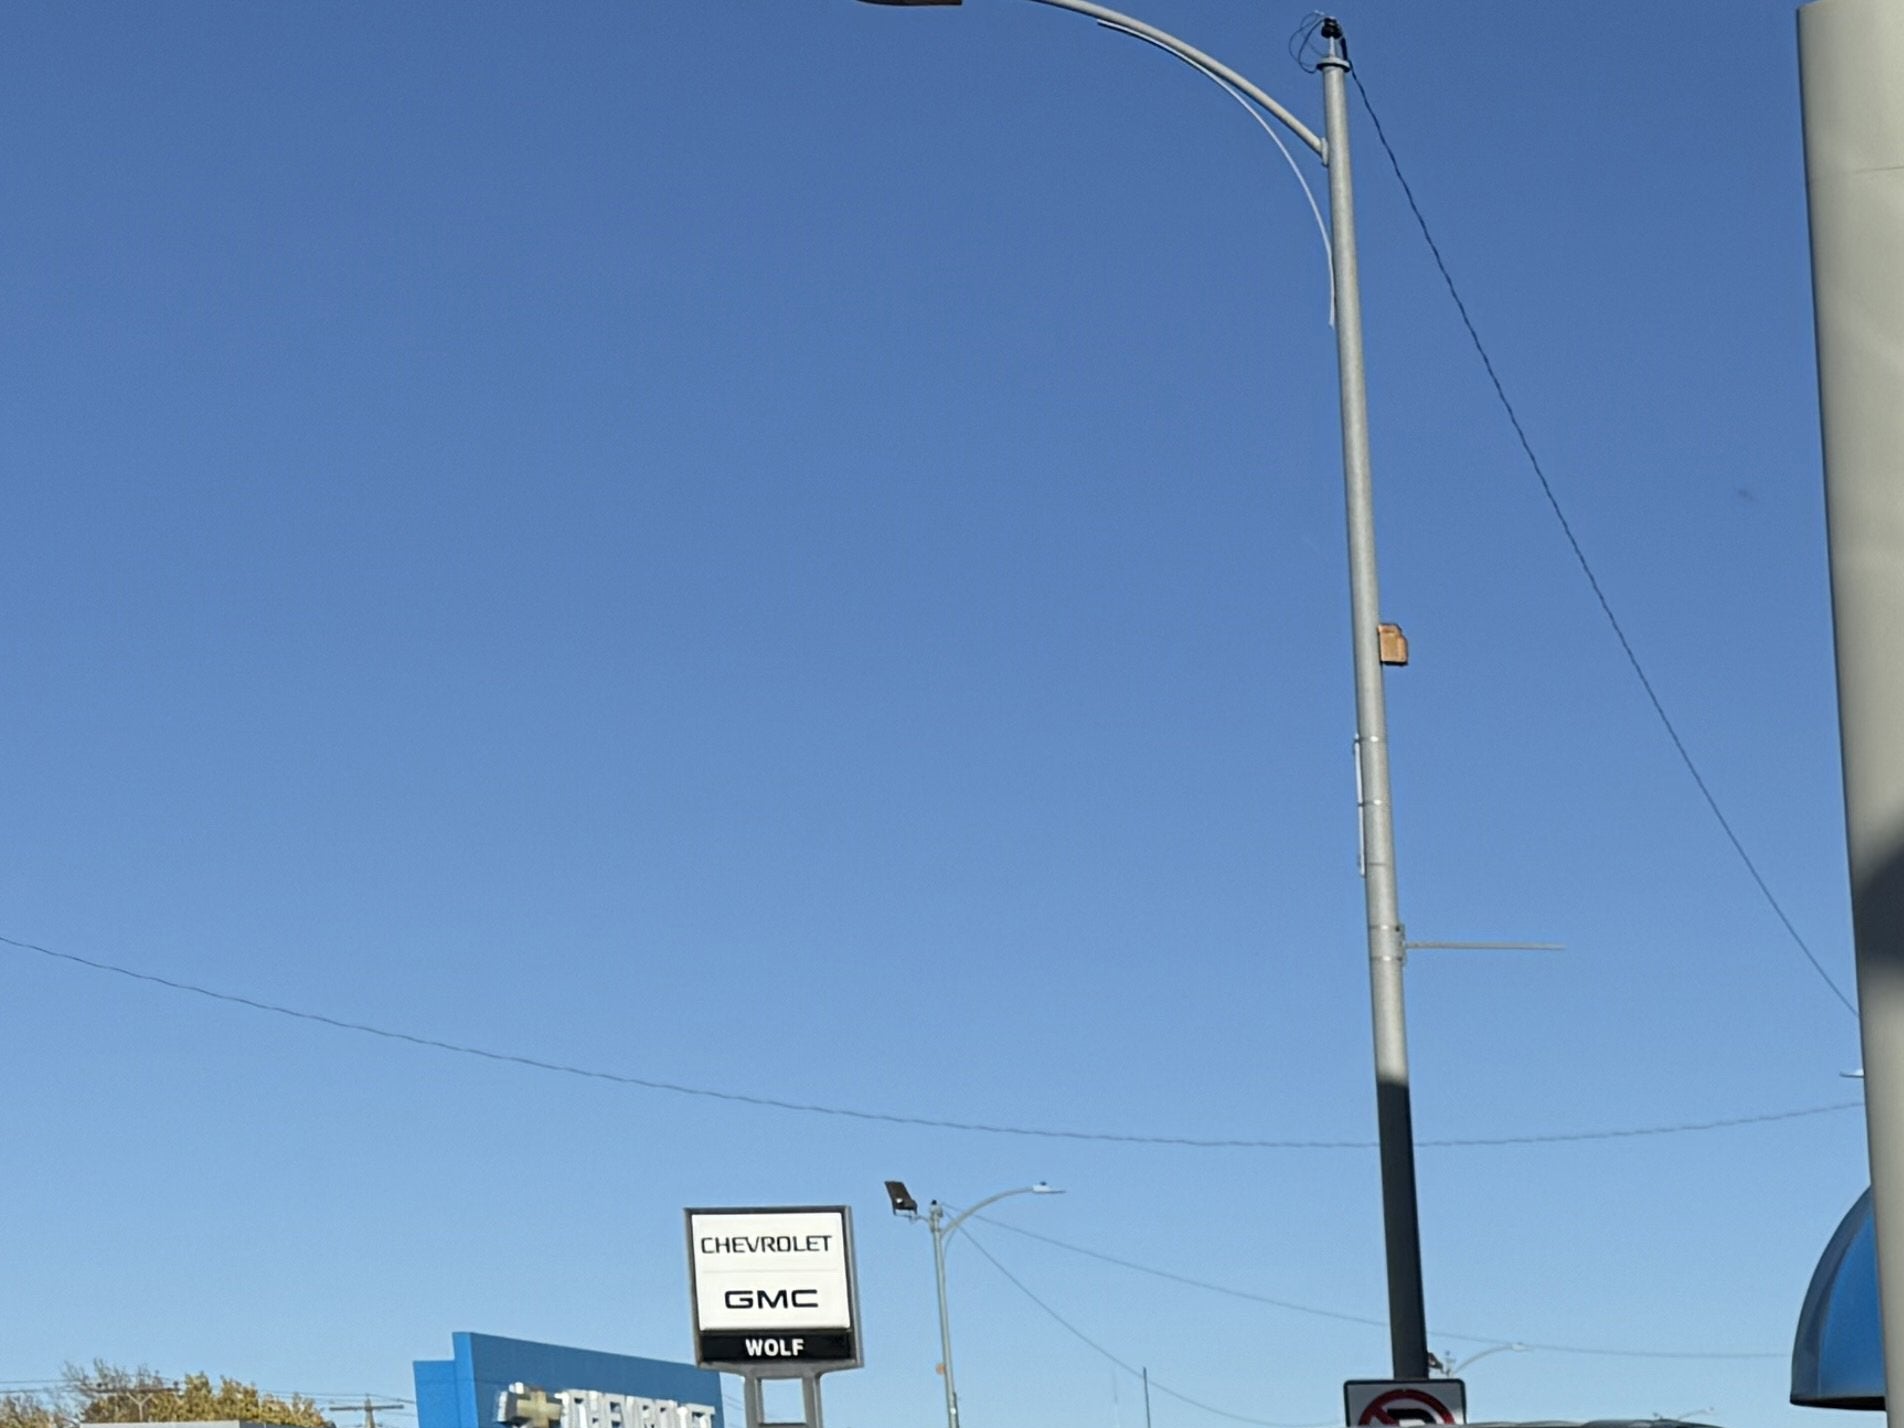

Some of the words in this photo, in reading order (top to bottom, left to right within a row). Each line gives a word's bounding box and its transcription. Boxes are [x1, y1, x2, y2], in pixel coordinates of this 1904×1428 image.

[701, 1235, 832, 1254] CHEVROLET
[724, 1289, 819, 1309] GMC
[745, 1338, 804, 1357] WOLF
